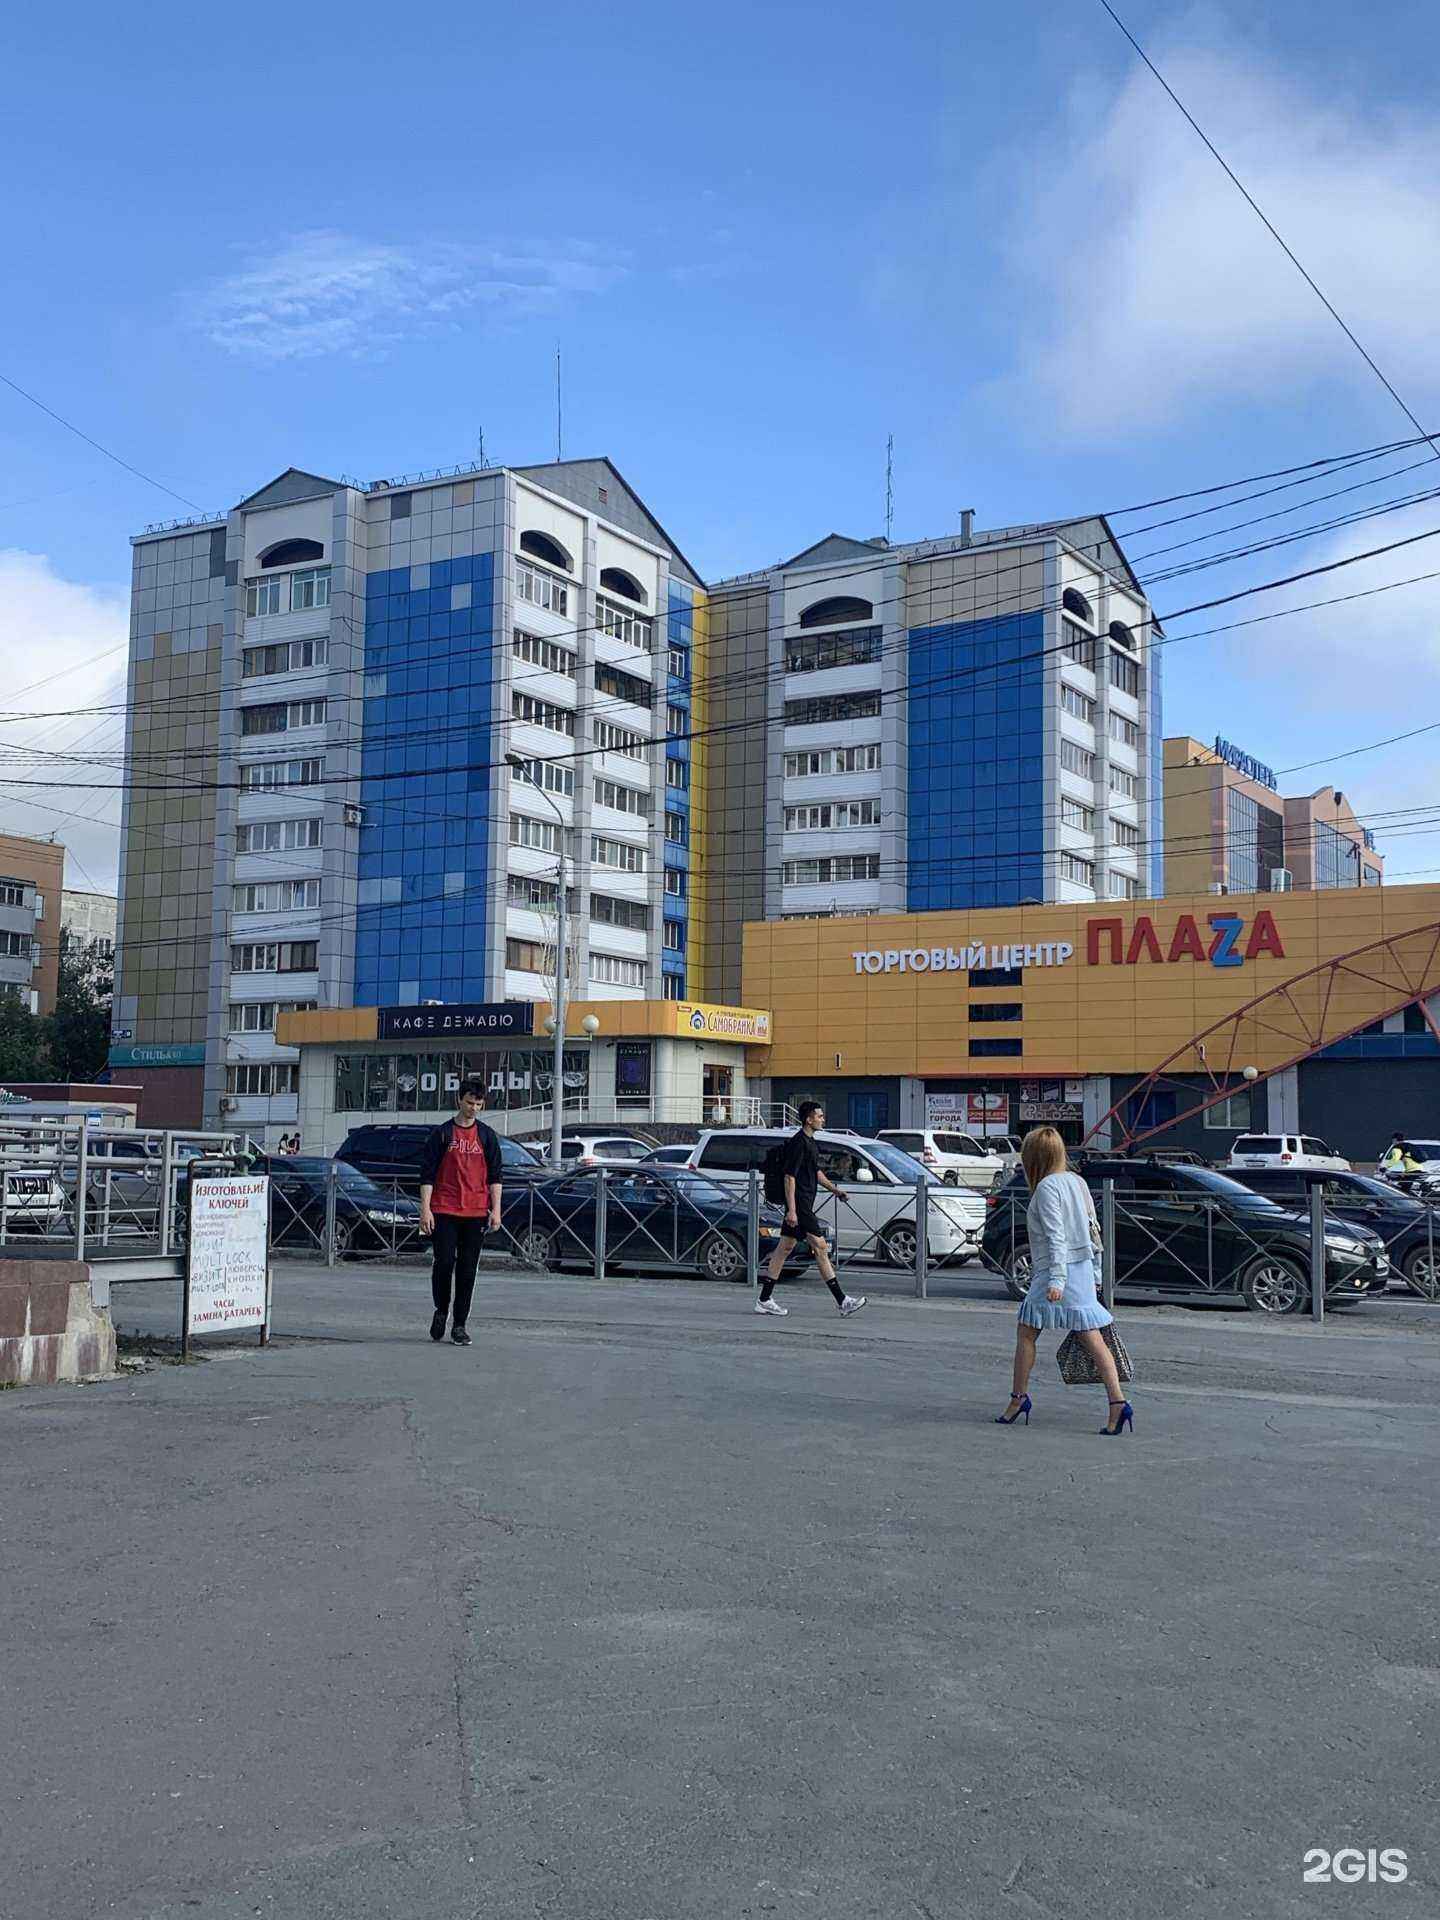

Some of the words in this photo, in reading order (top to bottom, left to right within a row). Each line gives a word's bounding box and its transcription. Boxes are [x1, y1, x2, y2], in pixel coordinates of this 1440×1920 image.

[852, 942, 986, 974] ТОРГОВЫЙ
[991, 942, 1073, 972] ЦЕНТР
[393, 1016, 435, 1028] КАФЕ
[443, 1014, 513, 1028] ДЕЖАВЮ
[448, 1138, 482, 1154] FILA
[195, 1183, 265, 1197] ИЗГОТОВЛЕНИЕ
[208, 1197, 249, 1209] КЛЮЧЕЙ
[213, 1299, 235, 1308] ЧАСЫ
